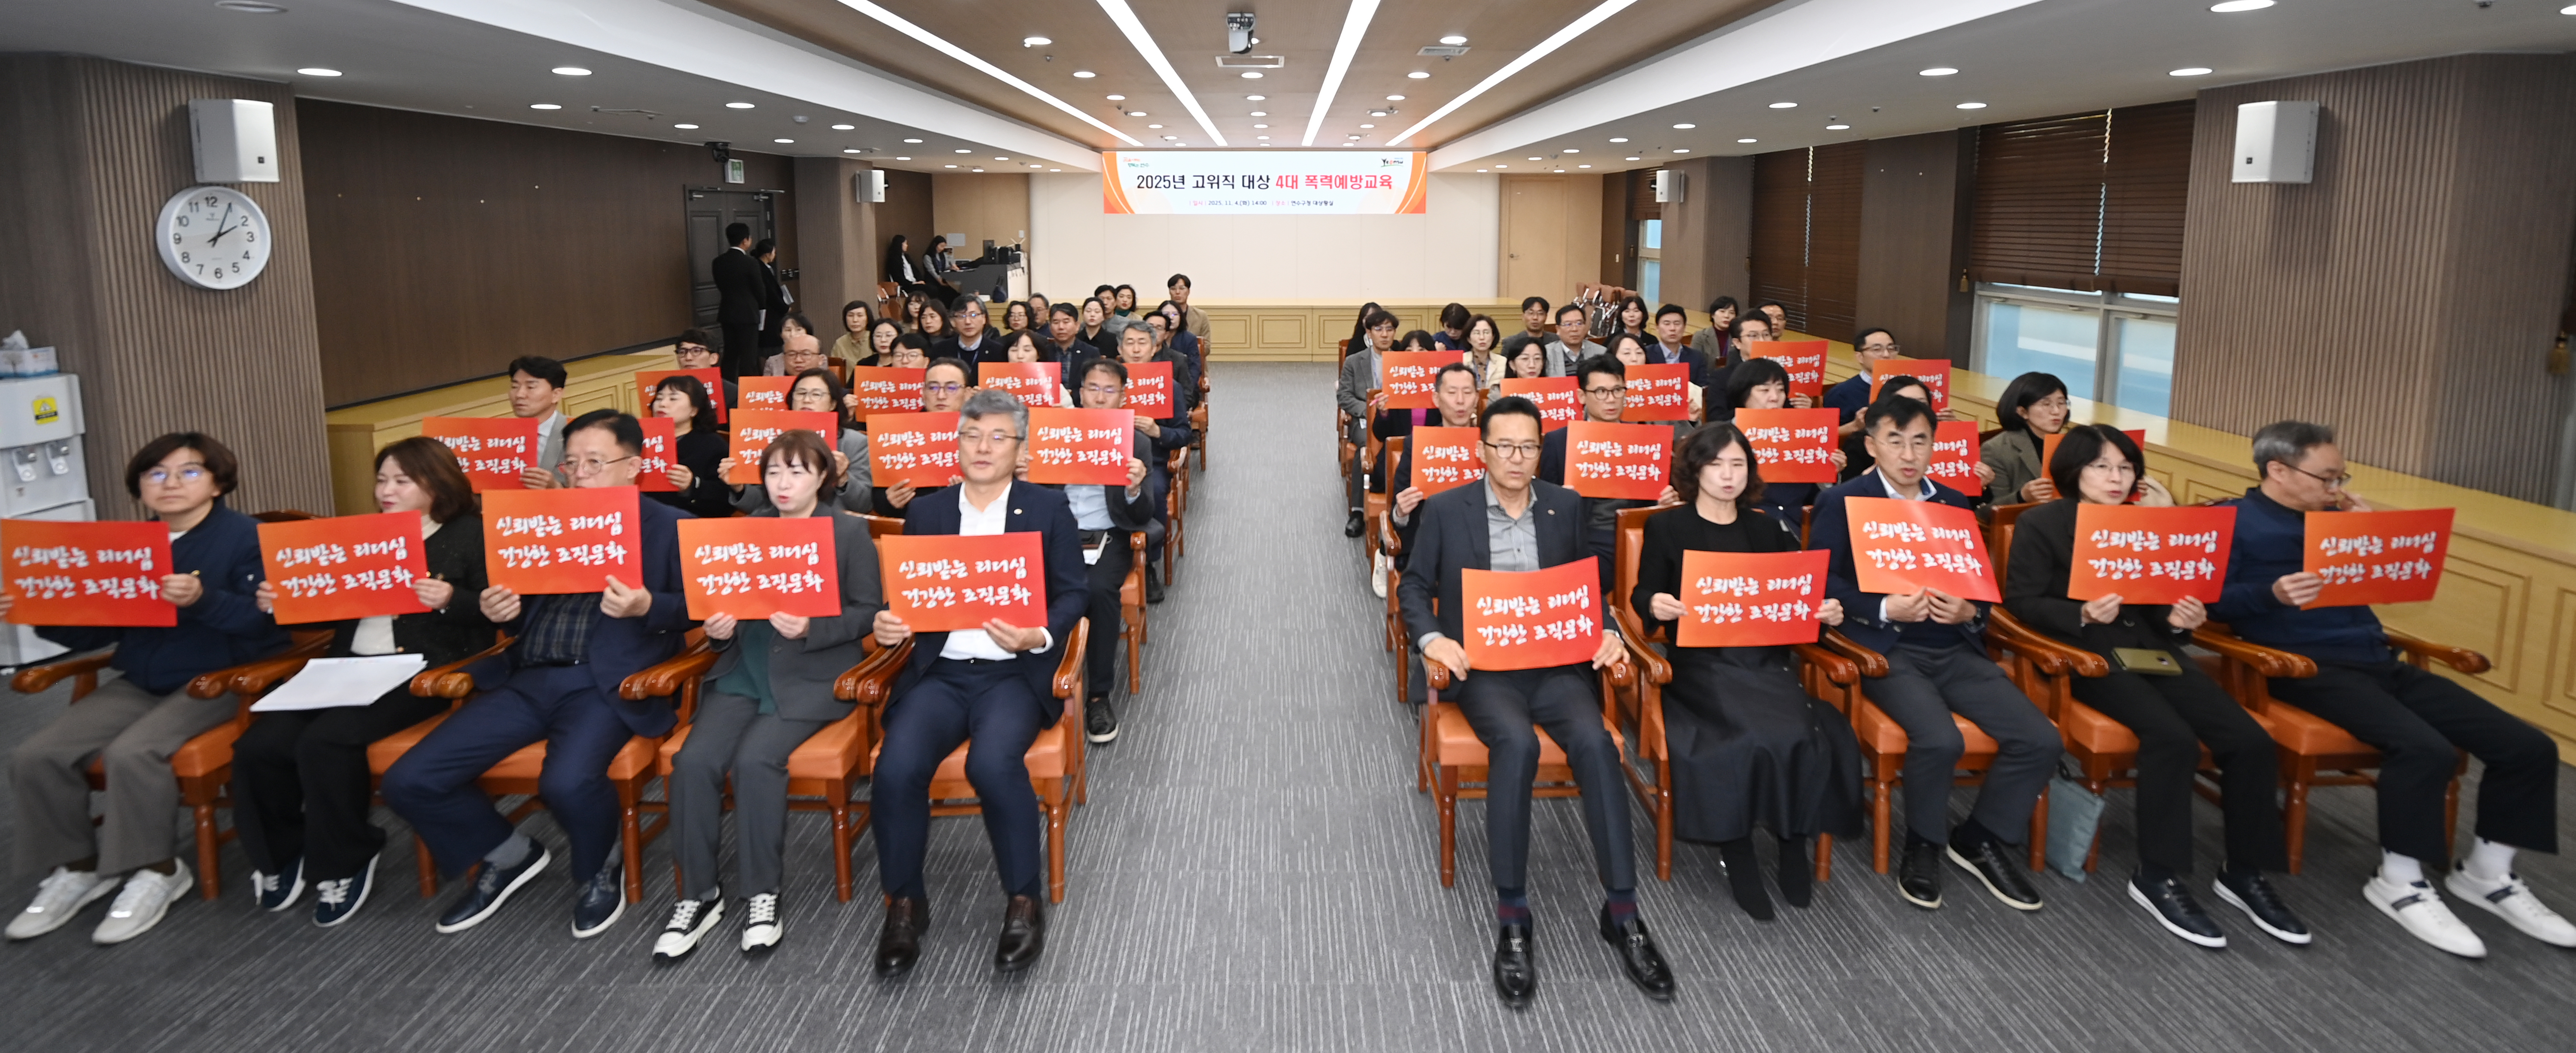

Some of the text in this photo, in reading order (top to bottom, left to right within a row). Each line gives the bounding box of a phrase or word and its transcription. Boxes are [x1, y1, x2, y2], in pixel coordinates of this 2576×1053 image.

[1137, 175, 1392, 189] 2025년 고위직 대상 4대 폭력예방교육
[188, 202, 199, 212] 11
[205, 196, 218, 207] 12
[176, 215, 189, 227] 10
[240, 215, 249, 226] 2
[173, 233, 182, 244] 9
[246, 231, 255, 242] 3
[182, 252, 190, 264] 8
[243, 250, 250, 260] 4
[196, 264, 204, 275] 7
[215, 267, 223, 279] 6
[232, 262, 240, 273] 5
[433, 435, 481, 452] 뢰받는
[920, 450, 960, 467] 조직문
[1753, 447, 1780, 464] 강한
[497, 512, 623, 537] 신뢰받는 리더십
[1863, 521, 1974, 549] 신뢰받는 리더십
[276, 537, 407, 567] 신뢰받는 리더십
[2091, 530, 2218, 552] 신뢰받는 리더십
[2321, 532, 2436, 556] 신뢰받는 리더십
[13, 546, 153, 571] 신뢰받는 리더십
[498, 541, 627, 568] 건강한 조직문화
[695, 542, 819, 565] 신뢰받는 리더십
[1866, 549, 1982, 576] 건강한 조직문화
[899, 557, 1027, 580] 신뢰받는 리더십
[2089, 558, 2215, 580] 건강한 조직문화
[2319, 558, 2431, 585] 건강한 조직문화
[15, 576, 159, 599] 건강한 조직문화
[281, 565, 414, 597] 건강한 조직문화
[697, 570, 824, 595] 건강한 조직문화
[1696, 574, 1812, 597] 신뢰받는 리더십
[902, 583, 1032, 608] 건강한 조직문화
[1476, 585, 1589, 617] 신뢰받는 리더십
[1694, 600, 1811, 624] 건강한 조직문화
[1477, 614, 1594, 646] 건강한 조직문화
